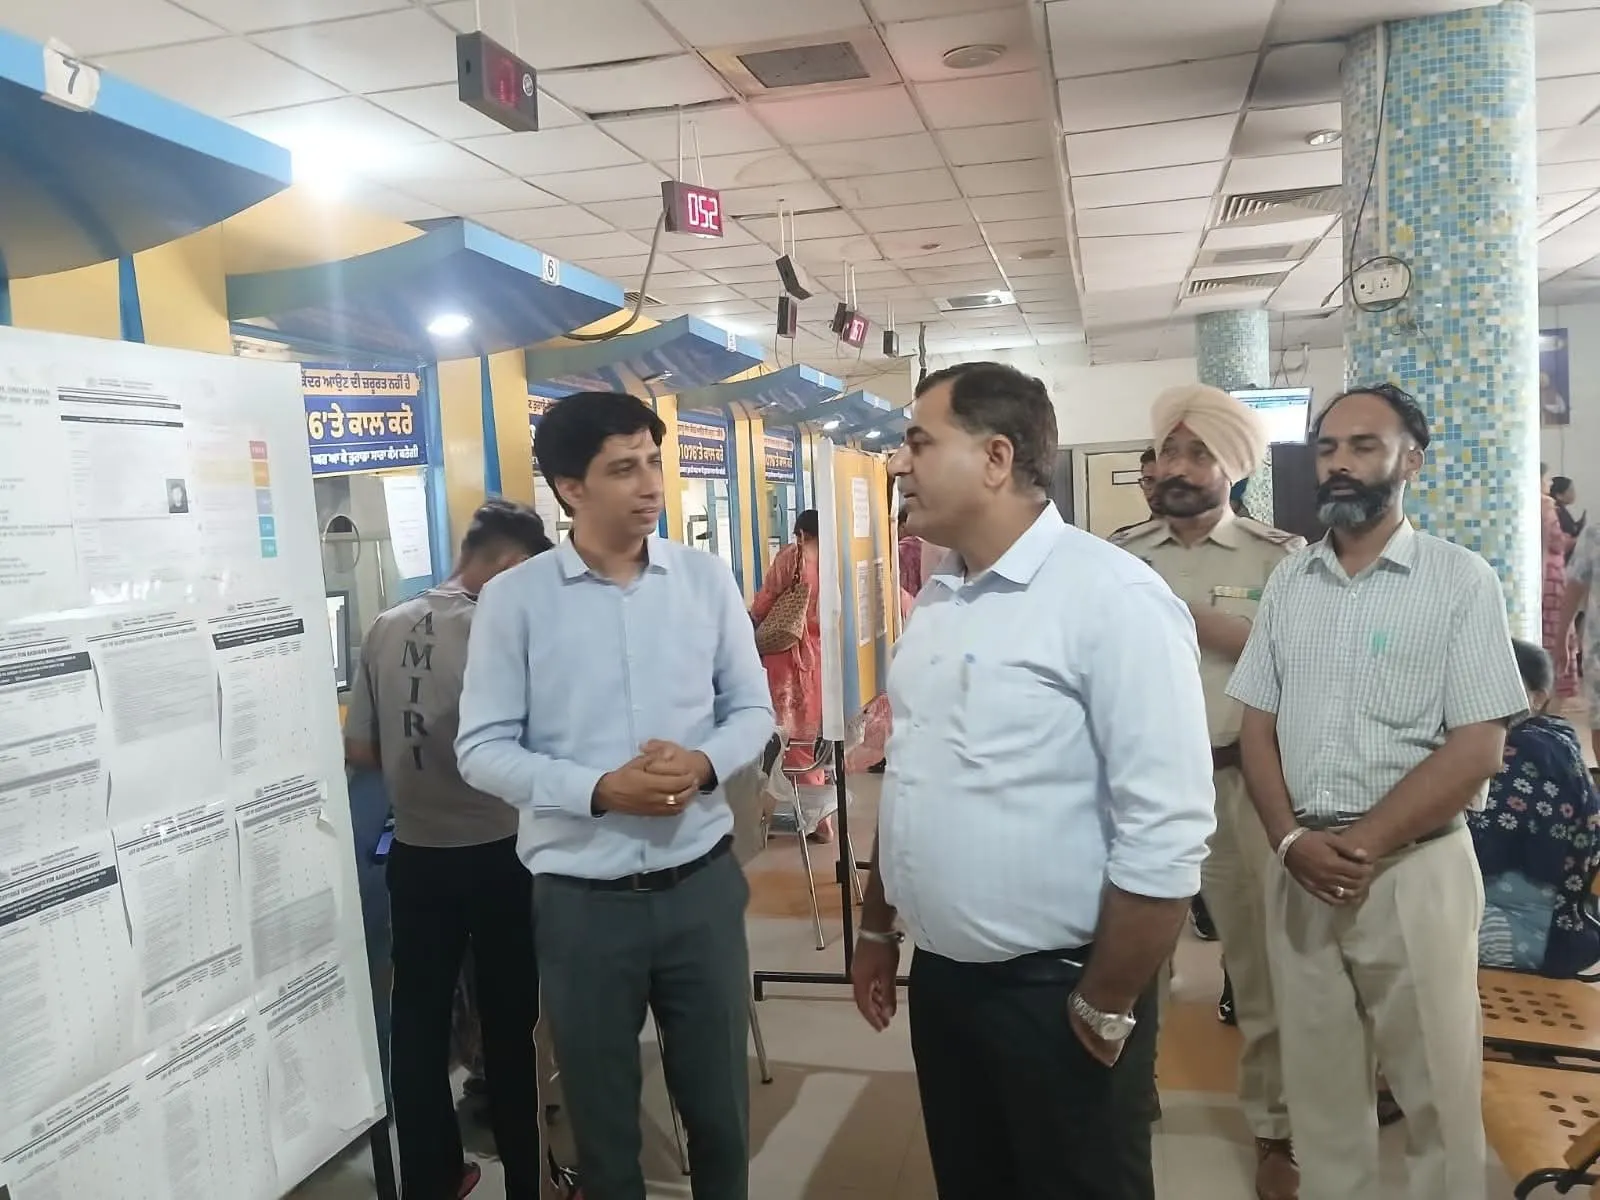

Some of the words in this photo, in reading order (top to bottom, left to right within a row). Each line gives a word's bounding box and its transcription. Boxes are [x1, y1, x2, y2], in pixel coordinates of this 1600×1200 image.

[62, 59, 81, 95] 7
[687, 193, 719, 230] 052
[547, 259, 554, 278] 6
[350, 372, 361, 389] ਦੀ
[346, 411, 385, 437] ਕਾਲ
[385, 402, 413, 436] ਕਰੋ
[401, 611, 434, 770] AMIRI
